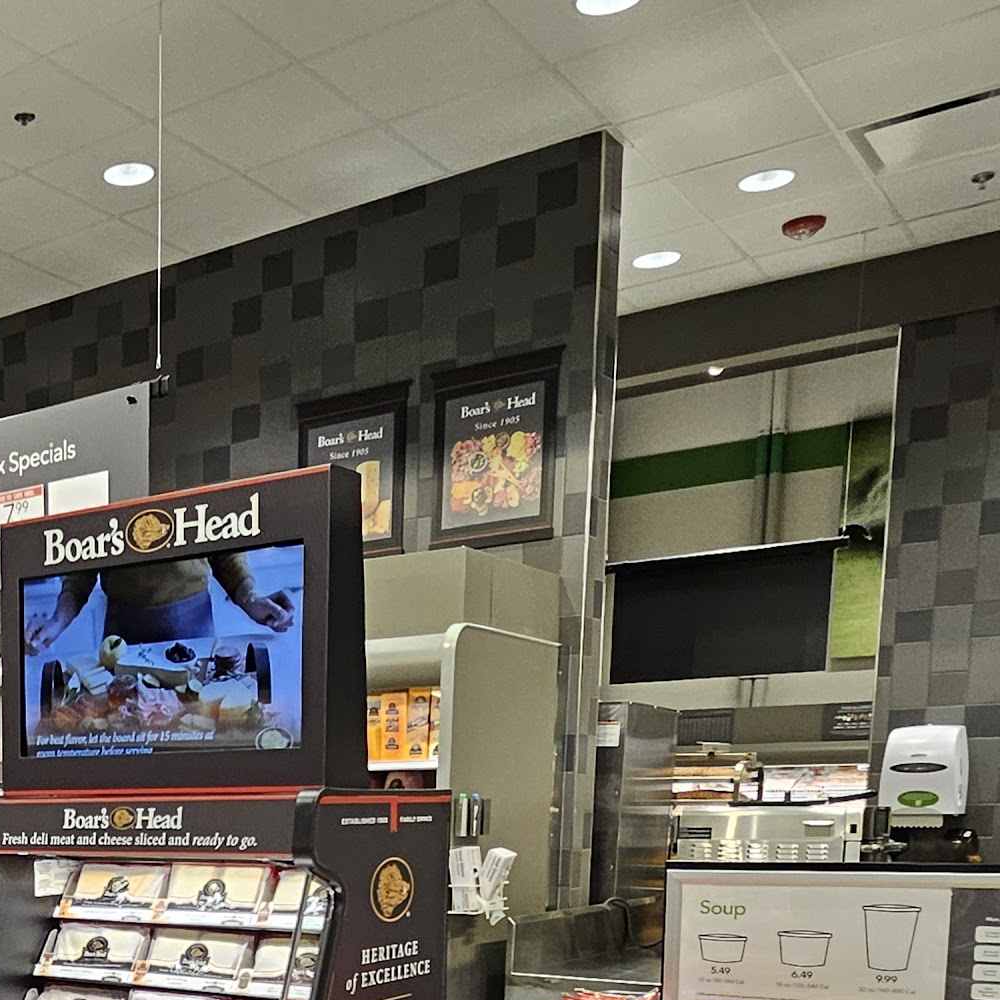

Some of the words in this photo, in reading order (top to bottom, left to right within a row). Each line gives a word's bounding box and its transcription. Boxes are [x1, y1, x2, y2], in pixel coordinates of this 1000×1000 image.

[461, 402, 491, 419] Boar's
[507, 392, 536, 409] Head
[475, 421, 497, 431] Since
[500, 415, 520, 426] 1905
[318, 433, 344, 447] Boar's
[358, 427, 383, 441] Head
[9, 439, 76, 476] Specials
[330, 451, 350, 460] Since
[351, 447, 369, 457] 1905
[44, 518, 125, 566] Boar's
[173, 493, 261, 547] Head
[36, 735, 49, 746] For
[50, 735, 63, 745] best
[63, 734, 87, 748] flavor,
[88, 733, 98, 743] let
[99, 732, 110, 743] the
[112, 731, 135, 742] board
[136, 731, 145, 742] sit
[146, 731, 158, 745] for
[160, 731, 169, 742] 15
[171, 731, 203, 741] minutes
[204, 730, 213, 740] at
[63, 807, 109, 830] Boar's
[136, 807, 183, 830] Head
[2, 833, 28, 846] Fresh
[30, 833, 48, 846] deli
[50, 834, 74, 846] meat
[76, 833, 96, 846] and
[98, 833, 133, 846] cheese
[135, 833, 165, 846] sliced
[168, 833, 190, 846] and
[192, 833, 224, 849] ready
[226, 834, 238, 847] to
[239, 836, 258, 850] go.
[700, 900, 746, 919] Soup
[361, 941, 418, 965] HERITAGE
[345, 973, 359, 995] of
[361, 960, 430, 988] EXCELLENCE
[711, 966, 731, 975] 5.49
[791, 971, 813, 979] 6.49
[876, 975, 898, 984] 9.99
